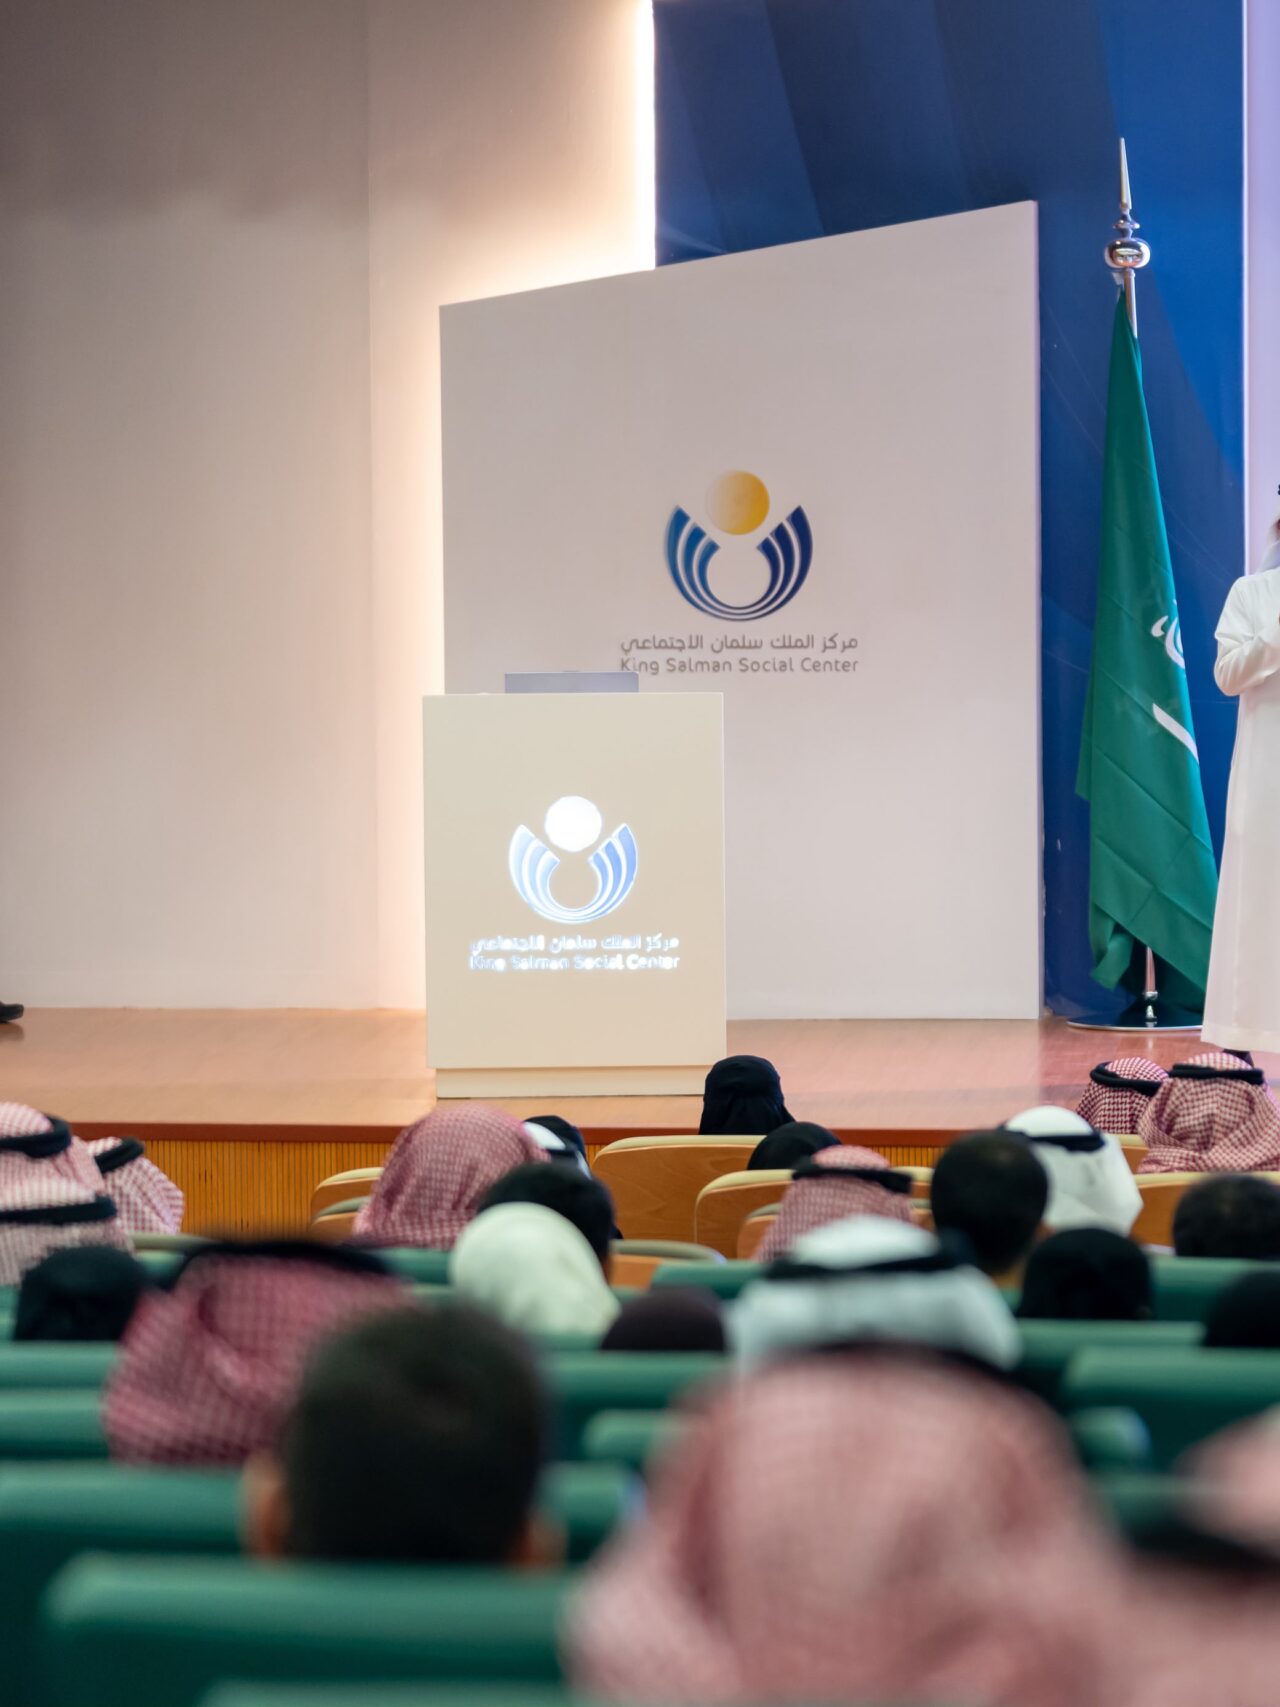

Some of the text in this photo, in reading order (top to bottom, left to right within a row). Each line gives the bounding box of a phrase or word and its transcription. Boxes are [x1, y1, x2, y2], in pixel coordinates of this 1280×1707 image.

[620, 633, 859, 654] مركز الملك سلمان الاجتماعي
[620, 656, 859, 675] King Salman Social Center
